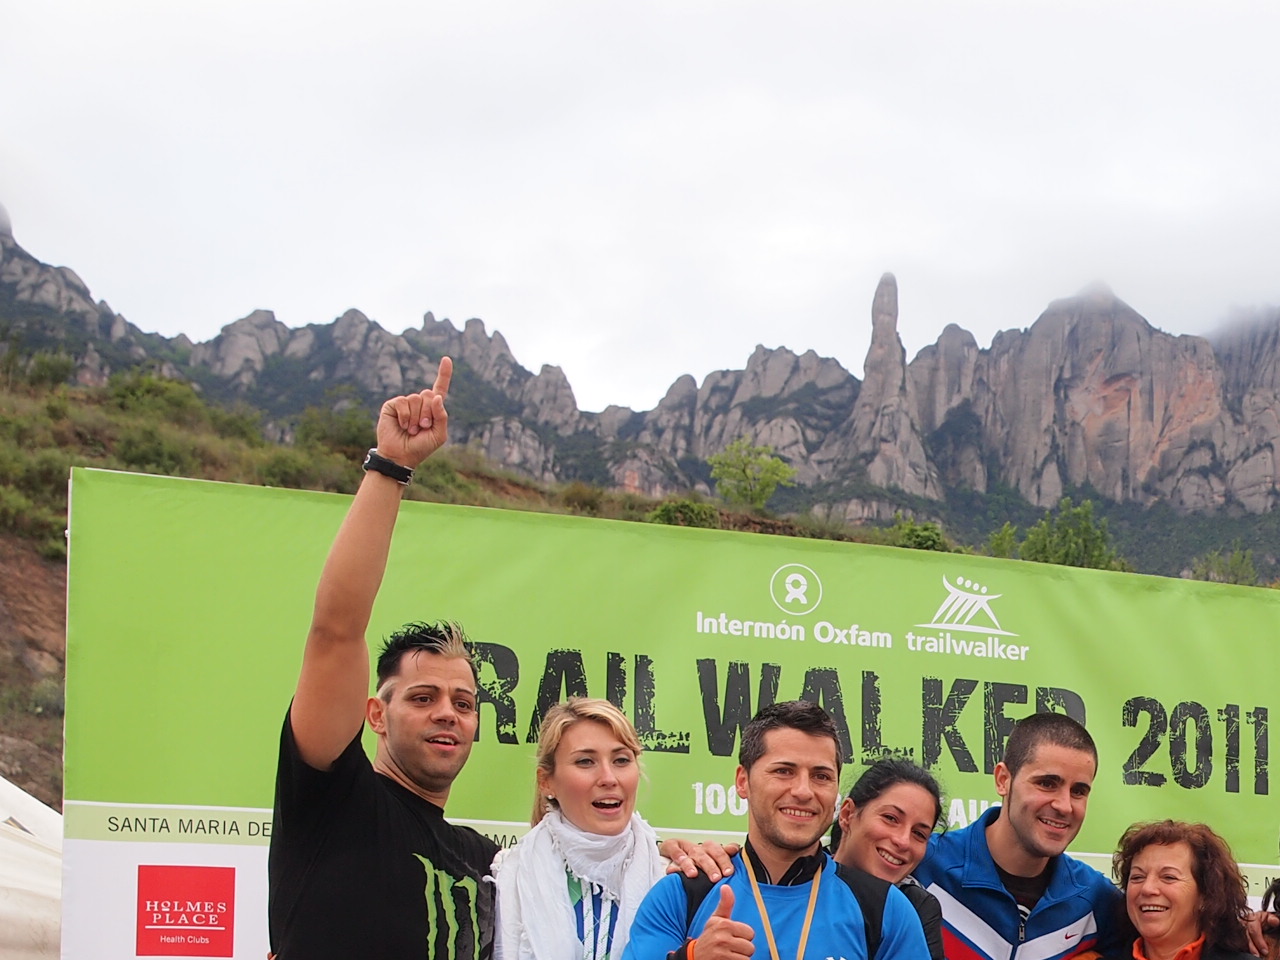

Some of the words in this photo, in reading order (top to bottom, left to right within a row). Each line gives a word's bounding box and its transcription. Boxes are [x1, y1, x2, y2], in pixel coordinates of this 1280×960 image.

[696, 611, 805, 642] Intermón
[813, 621, 892, 648] Oxfam
[905, 631, 1030, 661] trailwalker
[1122, 696, 1269, 796] 2011
[107, 816, 171, 834] SANTA
[178, 818, 241, 836] MARIA
[248, 821, 273, 838] DE
[145, 900, 228, 914] HOLMES
[152, 913, 219, 925] PLACE
[160, 935, 186, 944] Health
[187, 935, 210, 944] Clubs
